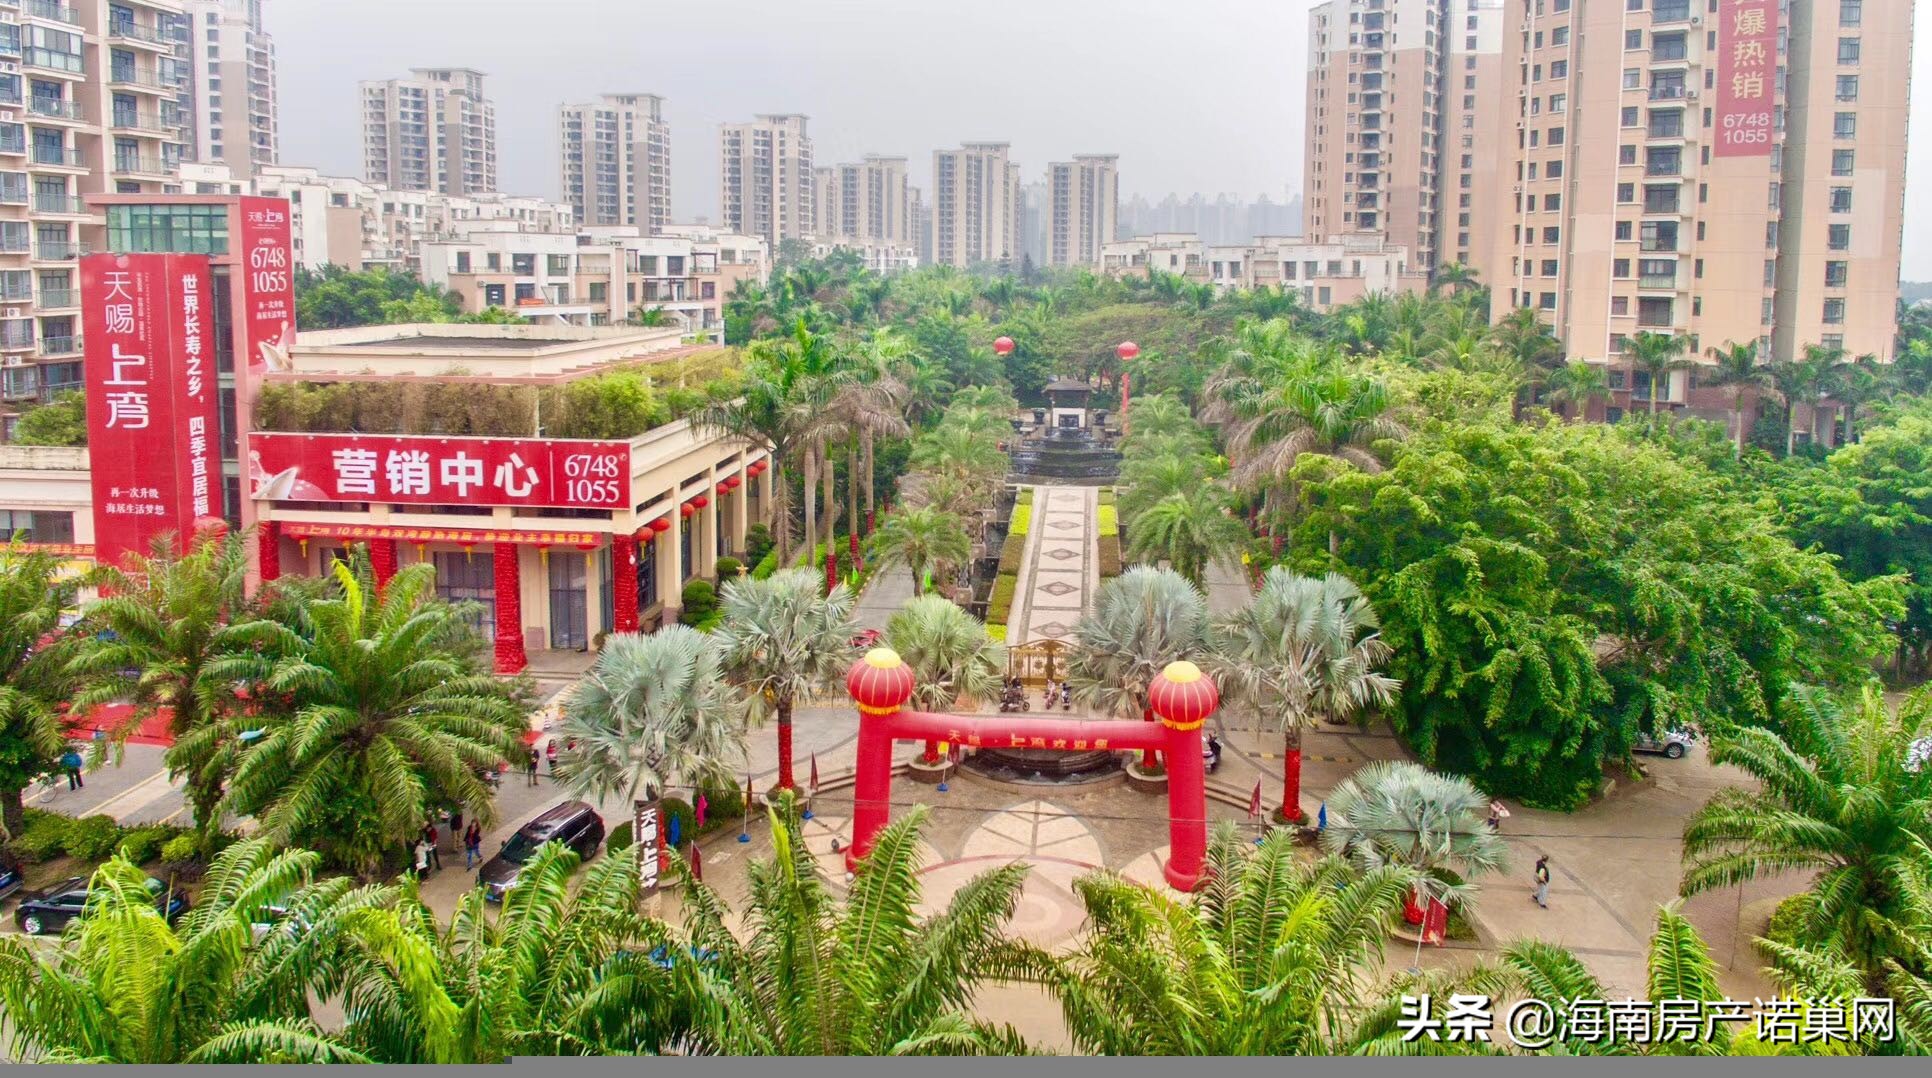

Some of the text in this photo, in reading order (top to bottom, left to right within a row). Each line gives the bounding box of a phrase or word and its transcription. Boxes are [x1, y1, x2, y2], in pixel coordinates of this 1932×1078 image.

[1731, 0, 1766, 99] 爆热销
[1723, 113, 1769, 128] 6748
[1723, 129, 1768, 144] 1055
[251, 247, 286, 268] 6748
[252, 271, 287, 293] 1055
[103, 271, 149, 429] 天赐上湾
[331, 448, 540, 497] 营销中心
[564, 454, 619, 478] 6748
[111, 487, 160, 499] 再一次升级
[565, 479, 620, 503] 1055
